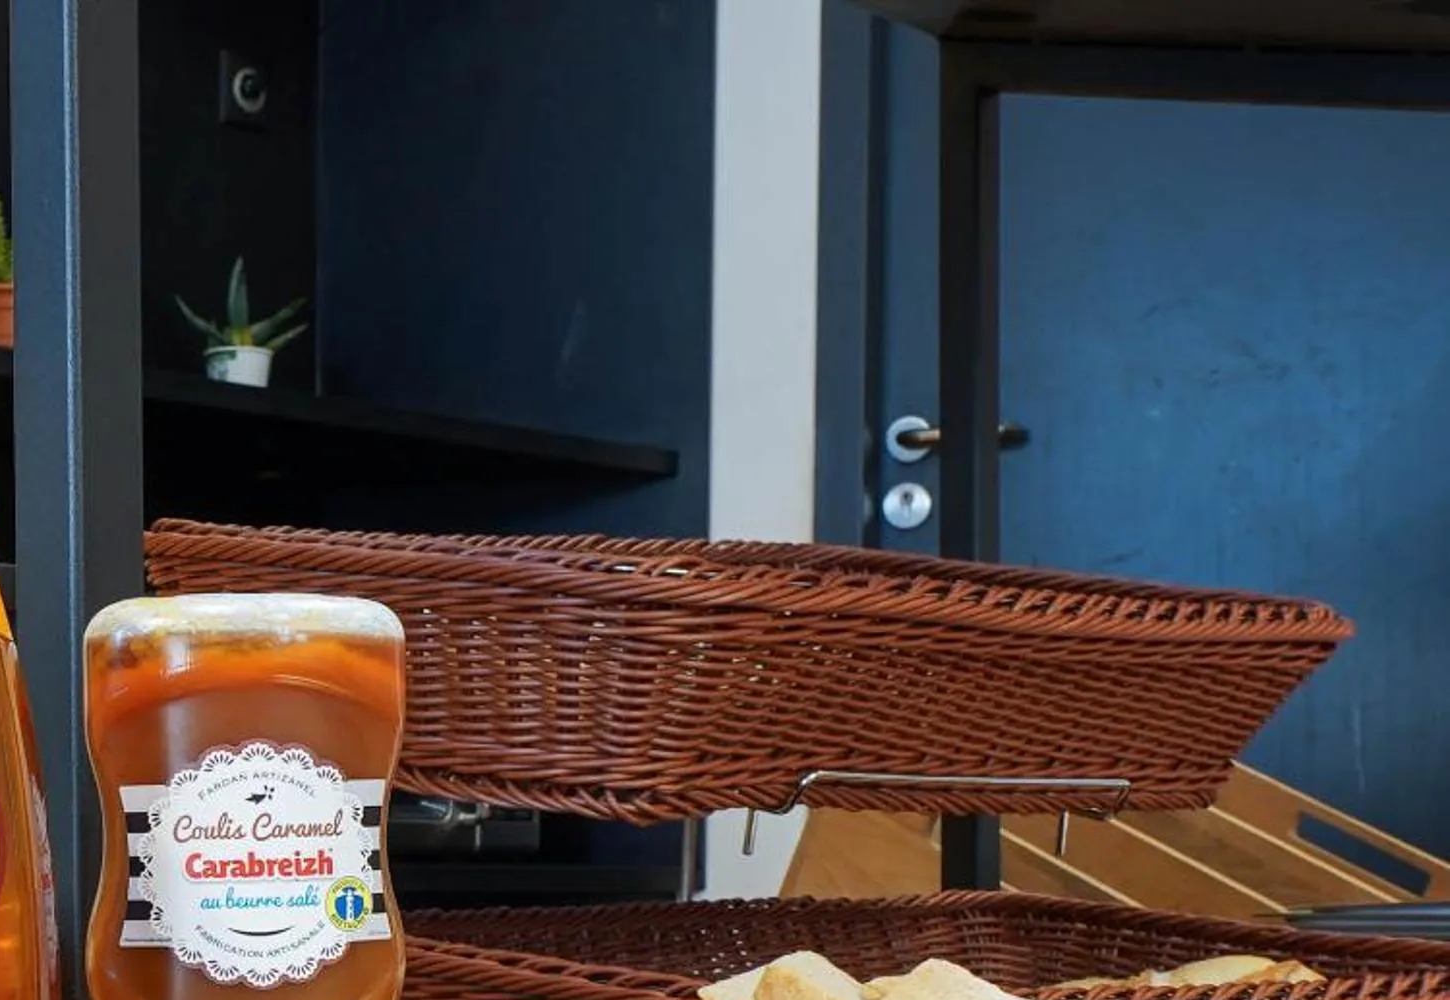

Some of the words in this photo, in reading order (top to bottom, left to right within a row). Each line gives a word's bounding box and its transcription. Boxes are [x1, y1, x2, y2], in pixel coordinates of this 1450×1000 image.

[172, 812, 247, 844] Coulis
[252, 809, 343, 842] Caramel
[185, 849, 334, 880] Carabreizh
[200, 896, 223, 910] au
[225, 886, 284, 910] beurre
[288, 885, 320, 909] salé
